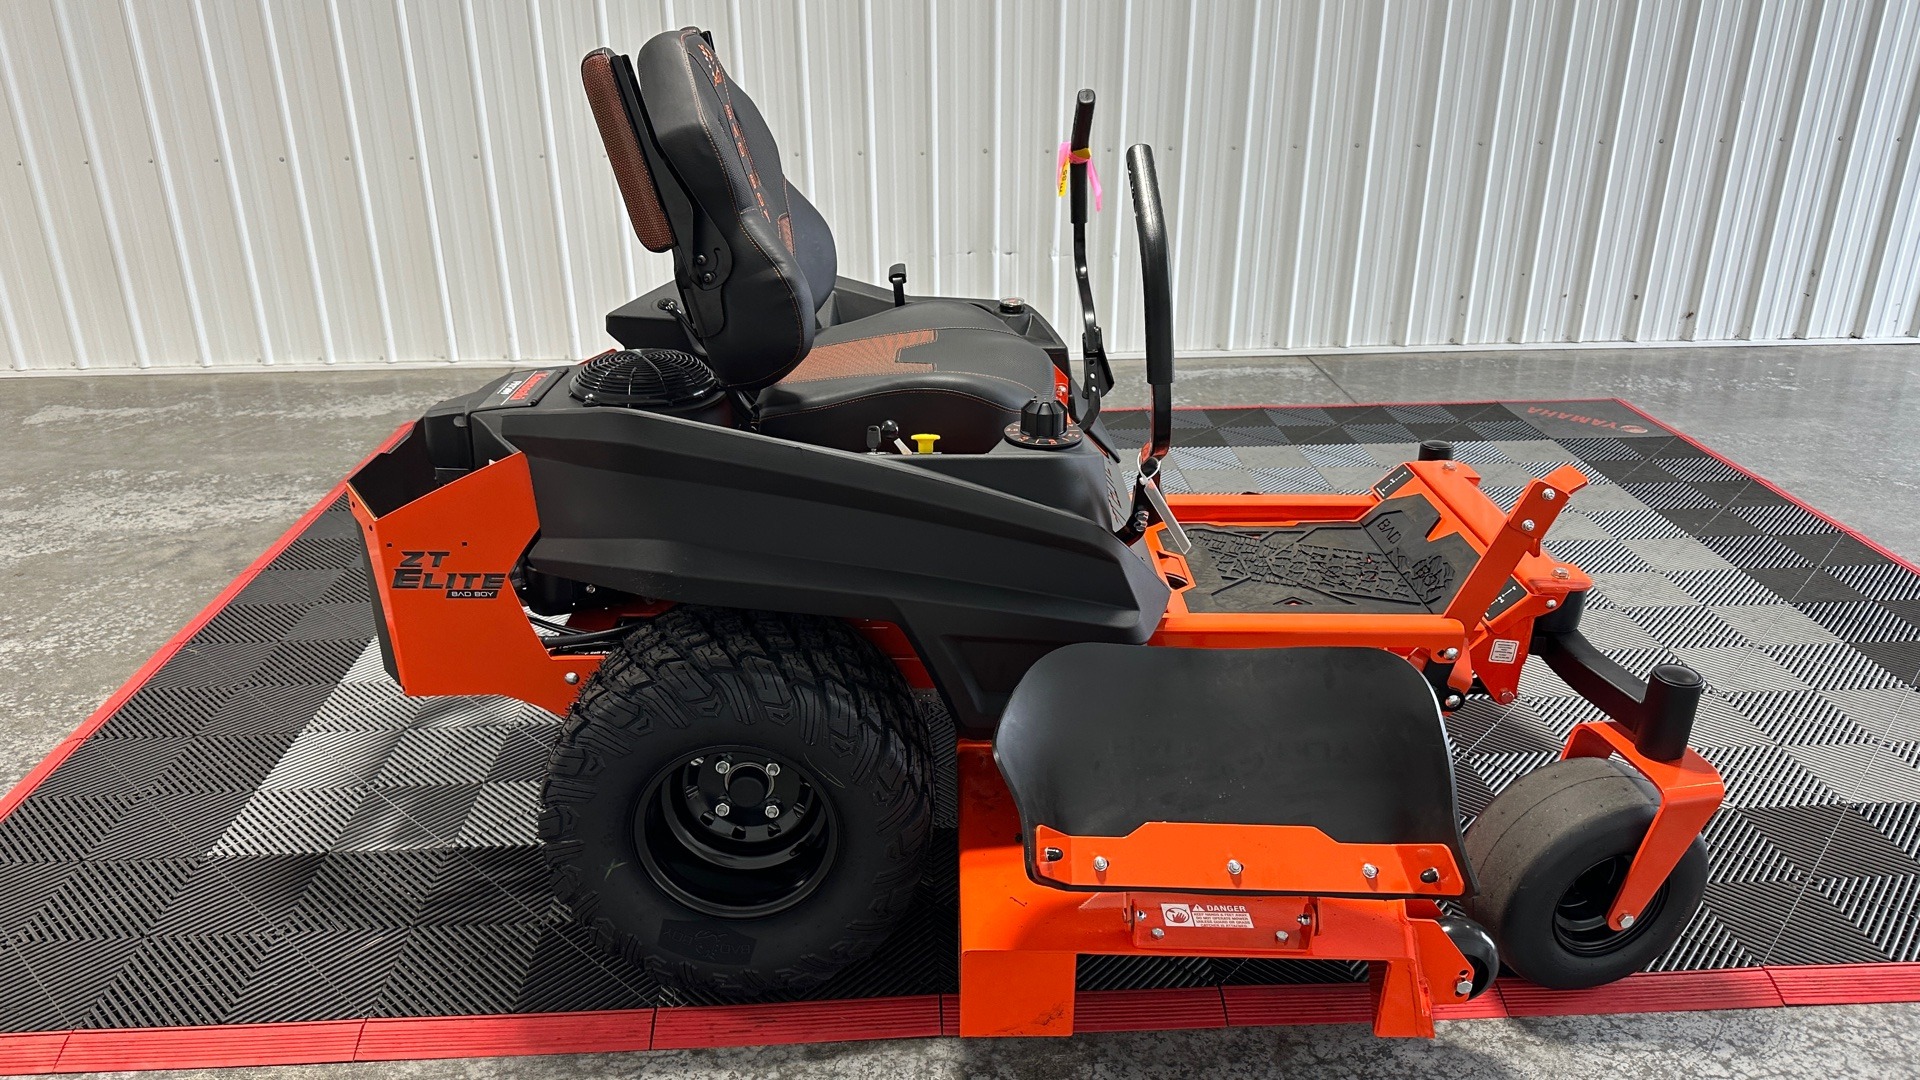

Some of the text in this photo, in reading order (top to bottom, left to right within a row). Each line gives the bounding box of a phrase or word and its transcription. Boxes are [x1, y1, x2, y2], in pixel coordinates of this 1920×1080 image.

[1527, 406, 1618, 429] YAMAHA
[1377, 518, 1402, 545] BAD
[400, 551, 451, 568] ZT
[1206, 904, 1247, 912] DANGER
